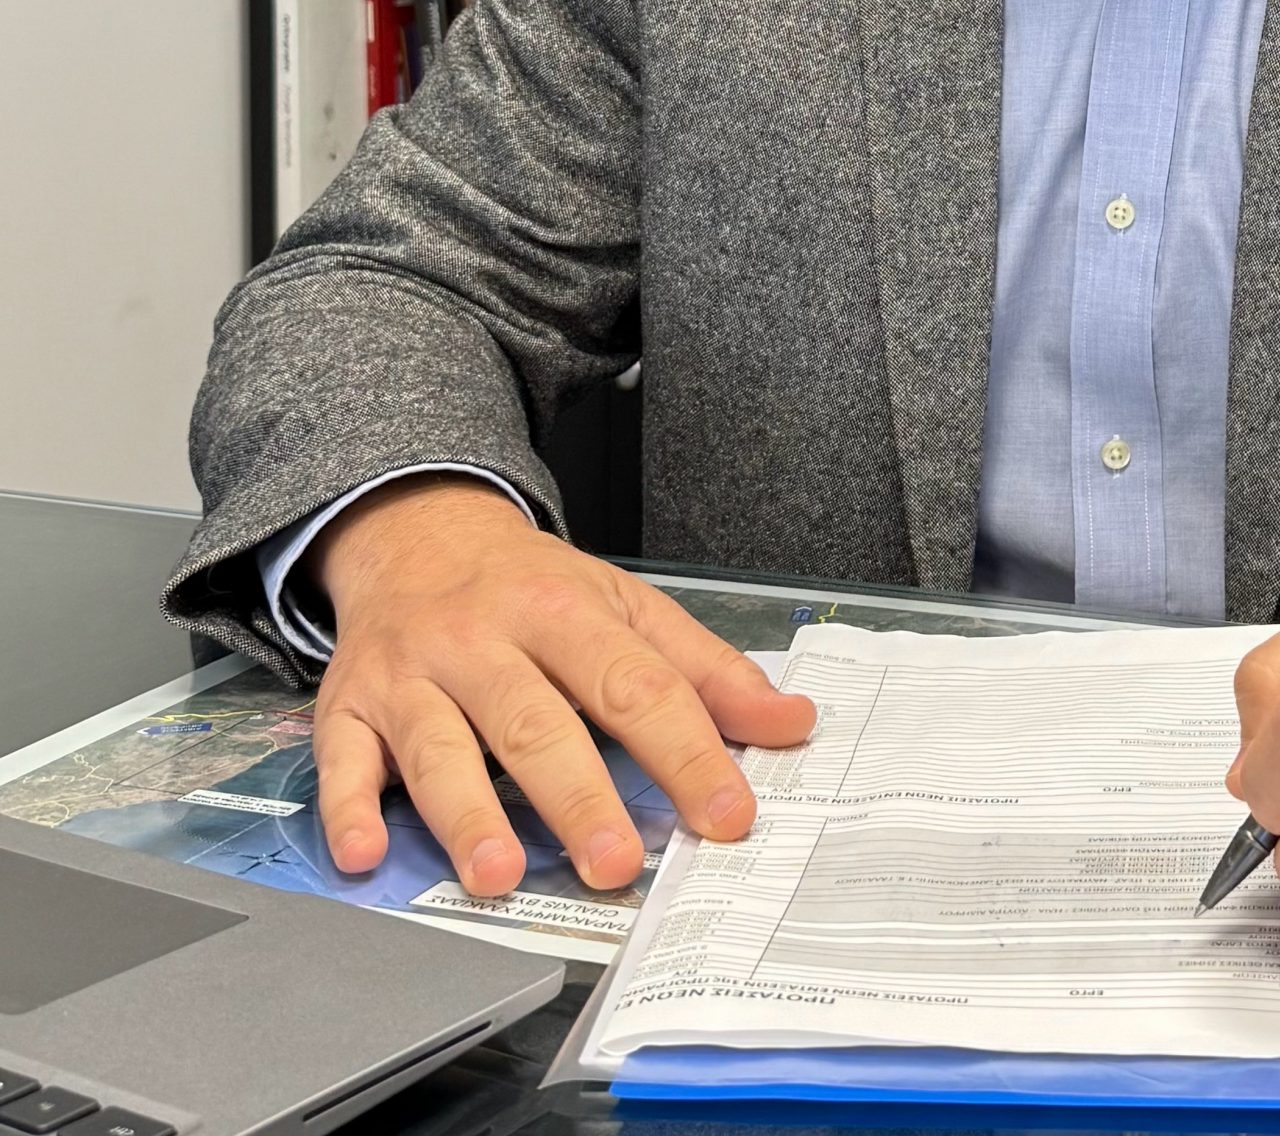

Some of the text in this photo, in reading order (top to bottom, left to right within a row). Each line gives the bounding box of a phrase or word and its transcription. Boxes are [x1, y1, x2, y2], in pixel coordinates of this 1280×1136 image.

[831, 792, 902, 804] ΕΝΤΑΞΕΩΝ
[905, 792, 943, 801] ΝΕΩΝ
[948, 796, 1020, 804] ΠΡΟΤΑΣΕΙΣ
[423, 895, 514, 914] ΧΑΛΚΙΔΑΣ
[541, 900, 620, 918] CHALKIS
[515, 909, 630, 932] ΠΑΡΑΚΑΜΨΗ
[743, 980, 829, 993] ΕΝΤΑΞΕΩΝ
[833, 988, 879, 998] ΝΕΩΝ
[640, 988, 706, 1005] ΝΕΩΝ
[710, 988, 837, 1005] ΠΡΟΤΑΣΕΙΣ
[882, 993, 969, 1004] ΠΡΟΤΑΣΕΙΣ
